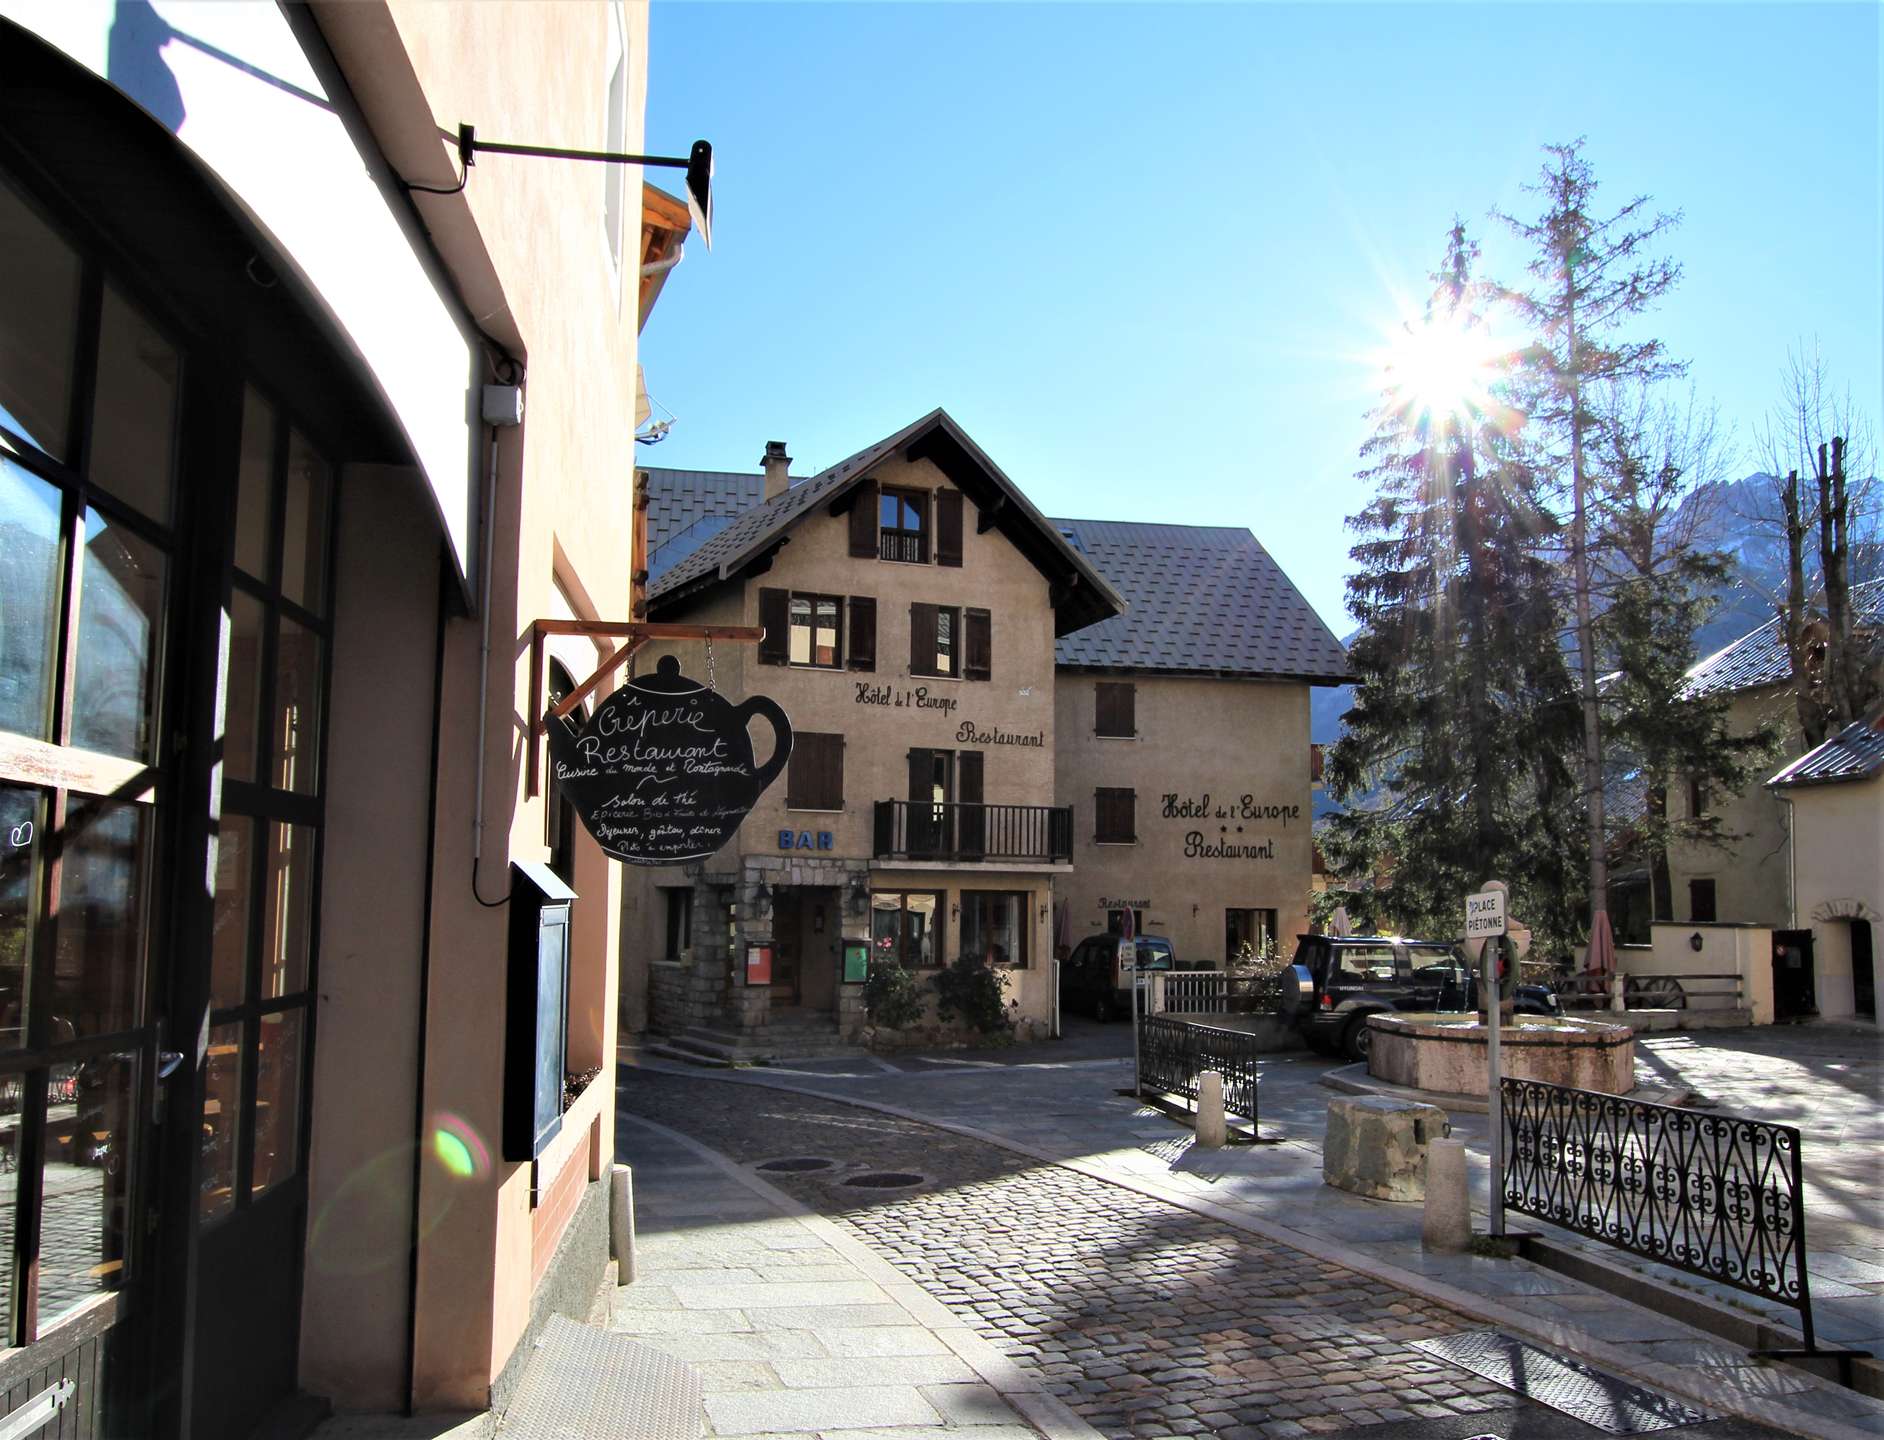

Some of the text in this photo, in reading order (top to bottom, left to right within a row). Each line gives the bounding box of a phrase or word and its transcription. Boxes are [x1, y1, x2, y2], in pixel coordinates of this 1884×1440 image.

[856, 682, 891, 706] Hôtel
[599, 697, 716, 737] Crêperie
[956, 721, 1044, 748] Restaurant
[577, 736, 728, 764] Restaurant
[556, 760, 598, 781] Cuisine
[666, 762, 676, 774] et
[651, 792, 670, 806] de
[674, 789, 698, 805] thé
[1161, 793, 1210, 819] Hôtel
[1215, 806, 1227, 819] de
[779, 830, 834, 850] BAR
[1184, 831, 1274, 859] Restaurant
[1097, 897, 1151, 910] Restaurant
[1474, 898, 1496, 912] PLACE
[1468, 915, 1502, 930] PIÉTONNE
